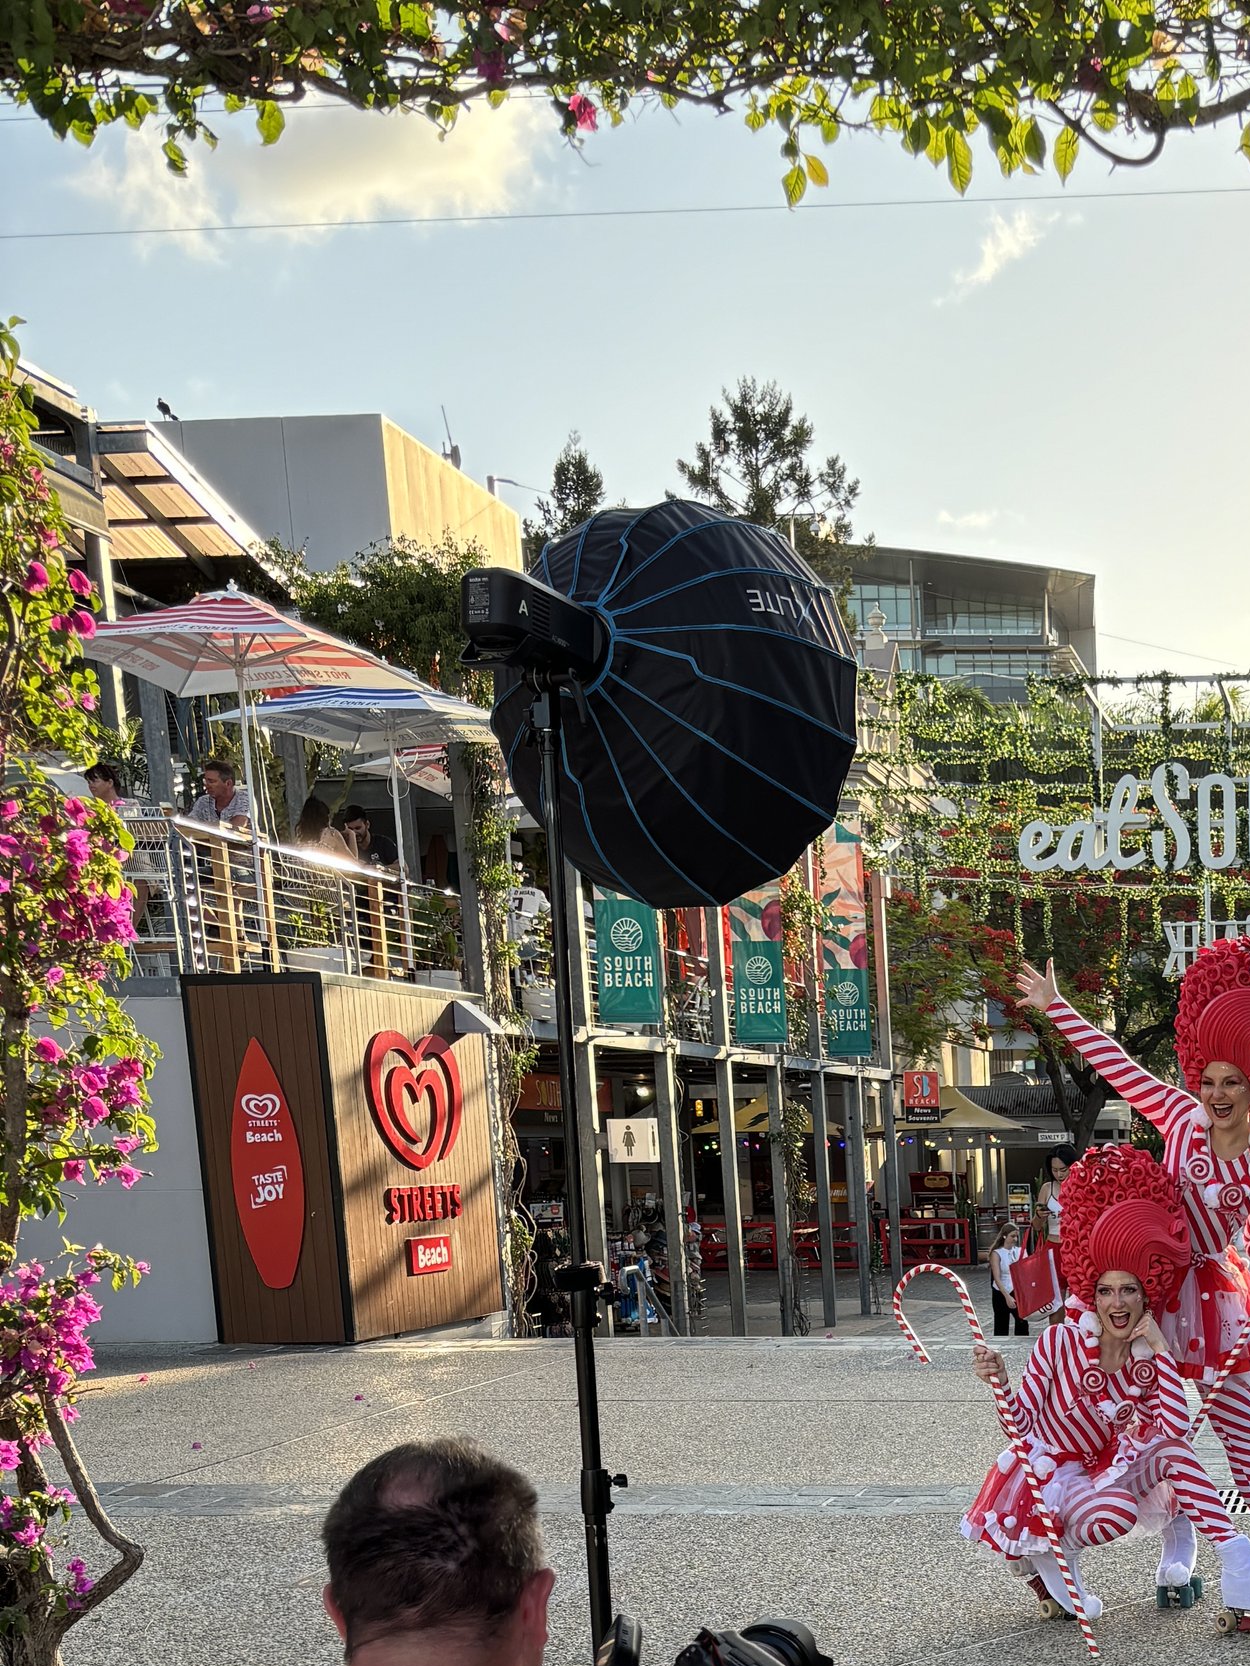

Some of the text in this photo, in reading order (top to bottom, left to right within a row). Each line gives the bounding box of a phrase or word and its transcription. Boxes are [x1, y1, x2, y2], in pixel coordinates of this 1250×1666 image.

[519, 600, 529, 616] A
[1018, 774, 1148, 872] eat
[603, 956, 653, 972] SOUTH
[603, 972, 654, 988] BEACH
[740, 987, 781, 1000] SOUTH
[740, 1000, 782, 1014] BEACH
[831, 1008, 867, 1020] SOUTH
[248, 1119, 278, 1127] STREETS
[246, 1129, 282, 1143] Beach
[252, 1172, 284, 1186] TASTE
[255, 1184, 284, 1203] JOY
[389, 1184, 464, 1221] STREETS
[417, 1239, 449, 1268] Beach
